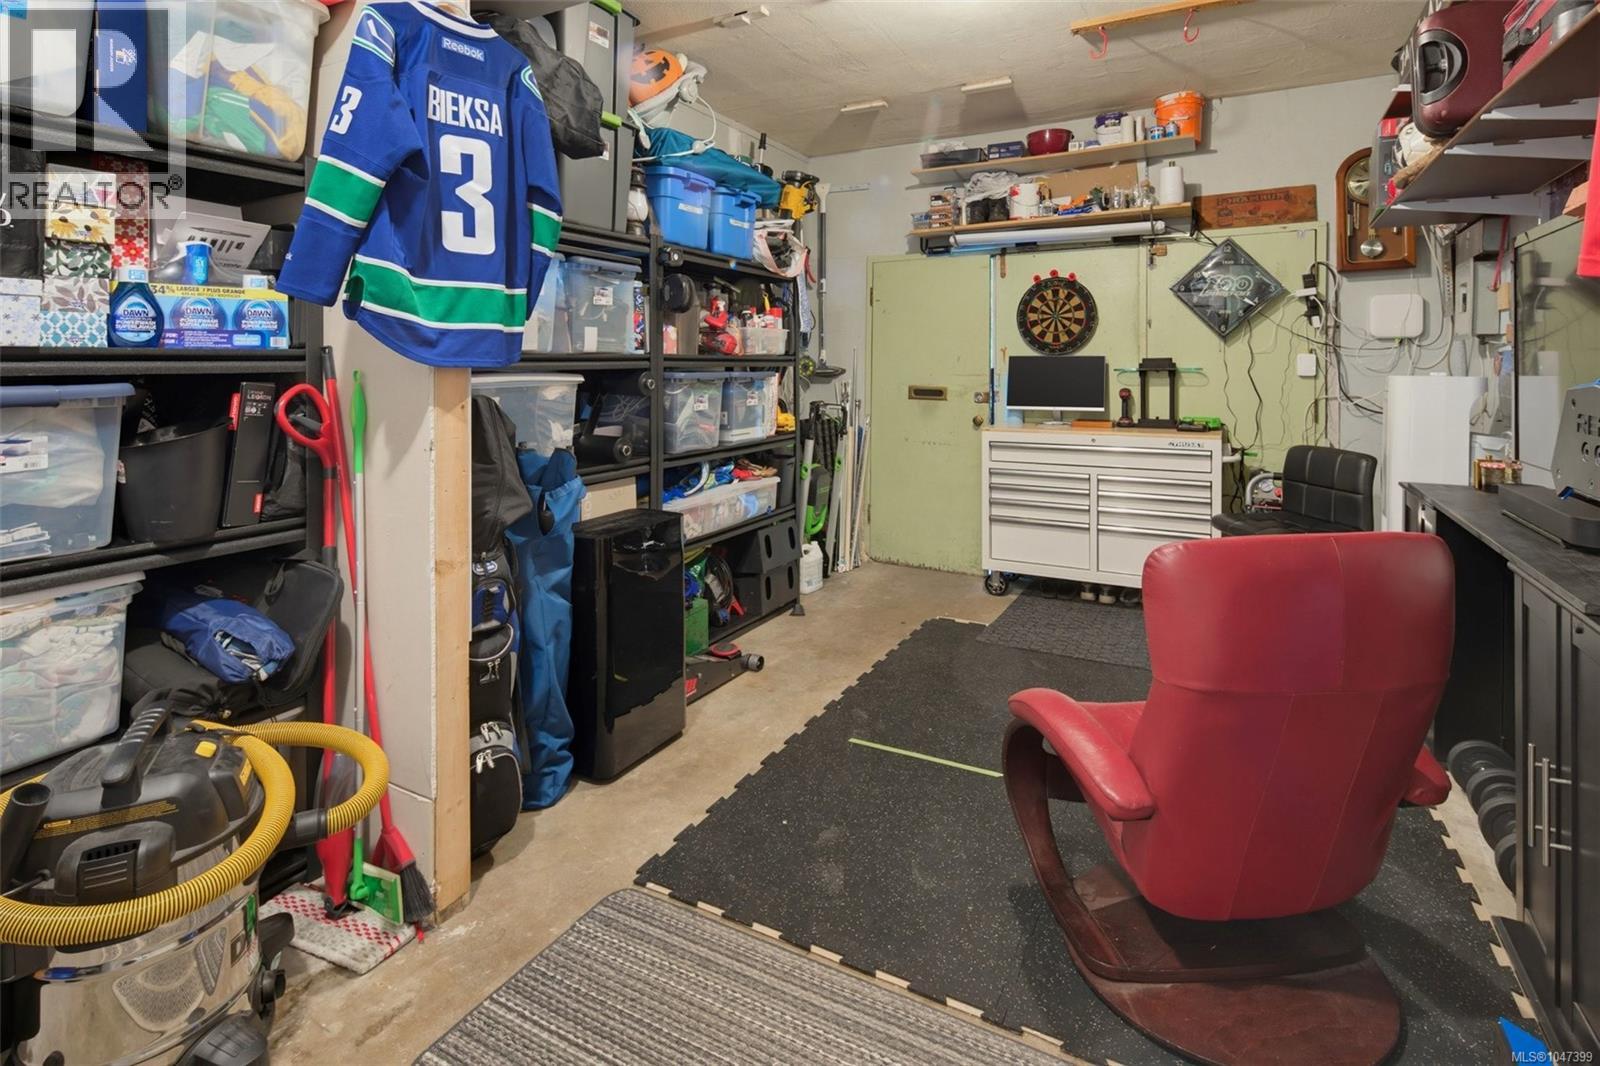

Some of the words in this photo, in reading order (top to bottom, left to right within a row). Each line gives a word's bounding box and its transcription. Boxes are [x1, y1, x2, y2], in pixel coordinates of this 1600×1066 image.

[442, 37, 485, 62] Reebok
[330, 86, 362, 135] 3
[428, 84, 503, 137] BIEKSA
[439, 135, 496, 255] 3
[123, 309, 149, 317] DAWN
[186, 307, 213, 316] DAWN
[247, 309, 272, 317] DAWN
